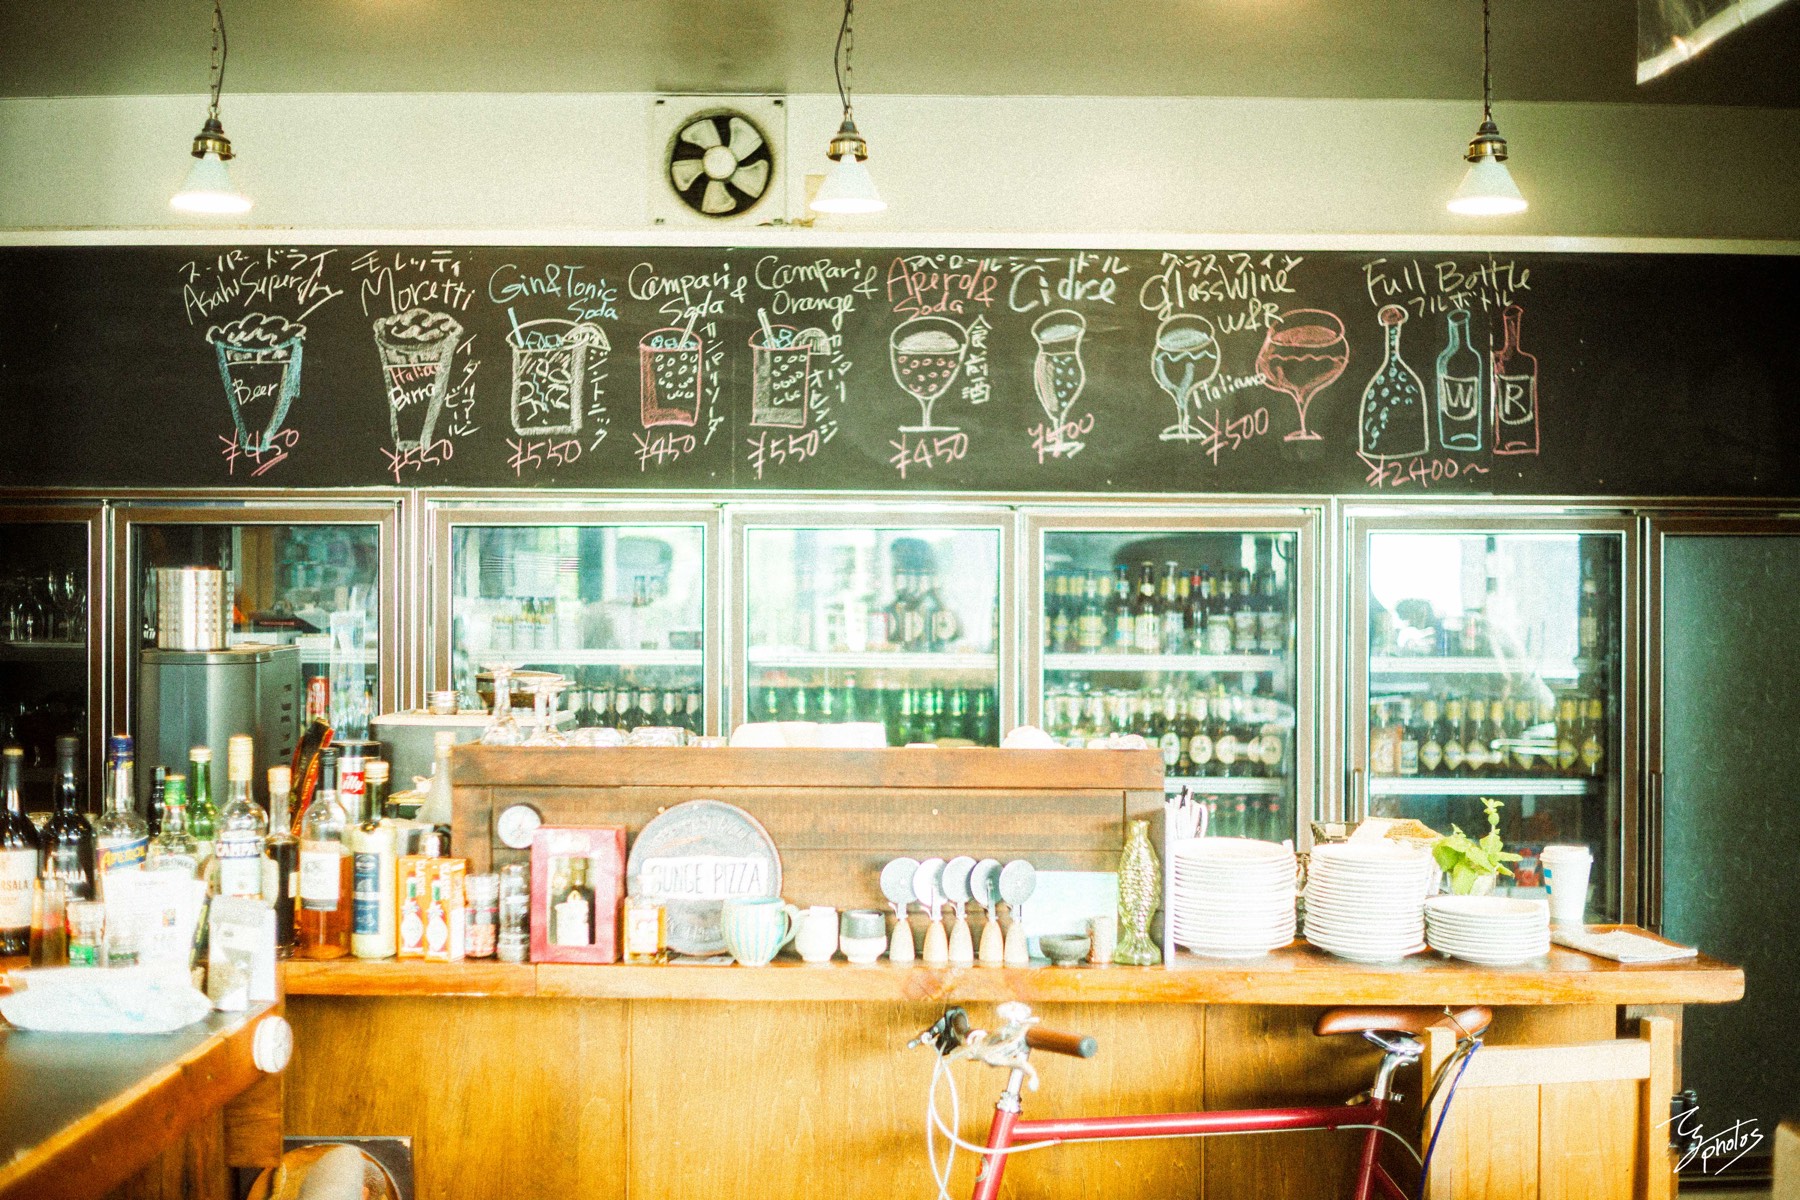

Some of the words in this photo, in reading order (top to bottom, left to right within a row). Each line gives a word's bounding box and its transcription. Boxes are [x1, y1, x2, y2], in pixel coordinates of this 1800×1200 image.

[361, 266, 476, 317] Moretti
[1008, 256, 1116, 313] Cidre
[1362, 257, 1427, 307] Full
[1435, 259, 1532, 294] Bottle
[567, 297, 619, 323] Soda
[659, 290, 725, 326] Soda
[772, 289, 856, 332] Orange
[893, 296, 964, 322] Soda
[232, 378, 279, 406] Beer
[1445, 382, 1474, 409] W
[1504, 383, 1527, 415] R
[632, 430, 696, 472] ¥450
[746, 430, 819, 480] ¥550
[888, 432, 969, 480] ¥450
[1197, 406, 1269, 467] ¥500
[505, 437, 582, 477] ¥550
[341, 773, 364, 793] illy
[713, 861, 762, 895] PIZZA
